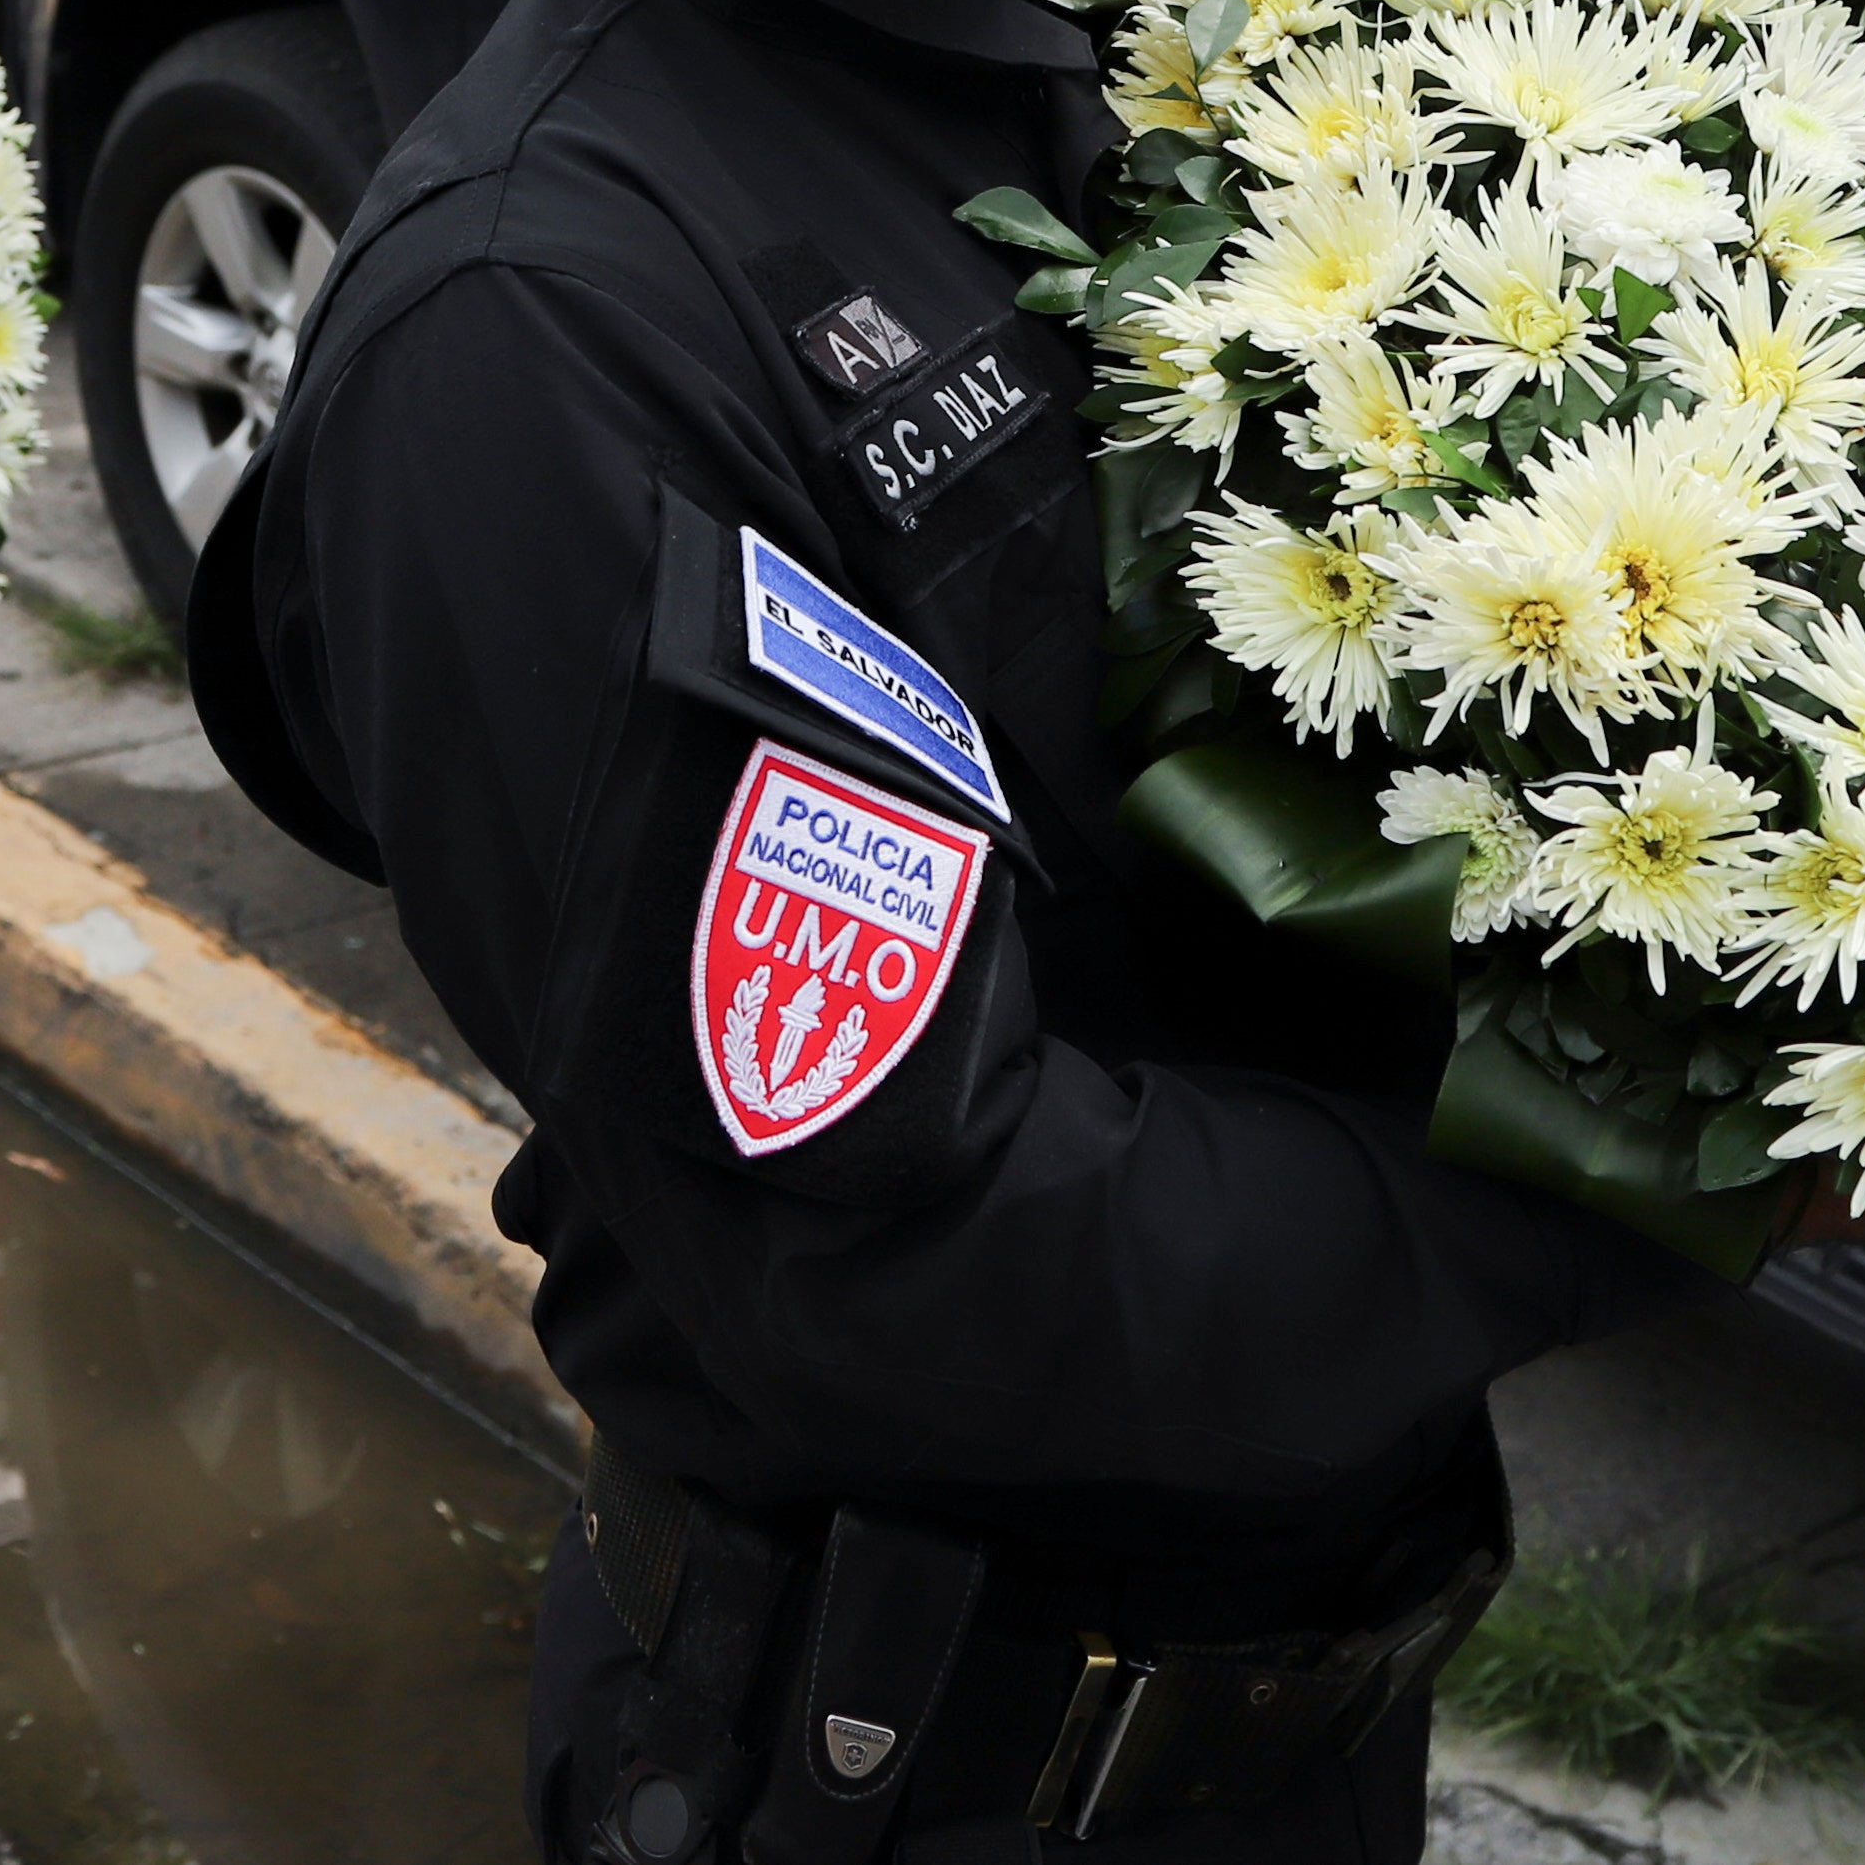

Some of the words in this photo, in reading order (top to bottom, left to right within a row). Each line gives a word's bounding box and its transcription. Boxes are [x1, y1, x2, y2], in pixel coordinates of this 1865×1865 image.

[827, 330, 881, 384] A
[933, 354, 1027, 442] DIAZ
[765, 594, 804, 636] EL
[817, 629, 978, 761] SALVADOR
[748, 832, 876, 905] NACIONAL
[881, 886, 938, 932] CIVIL
[776, 795, 933, 891] POLICIA
[733, 877, 918, 1003] U.M.O
